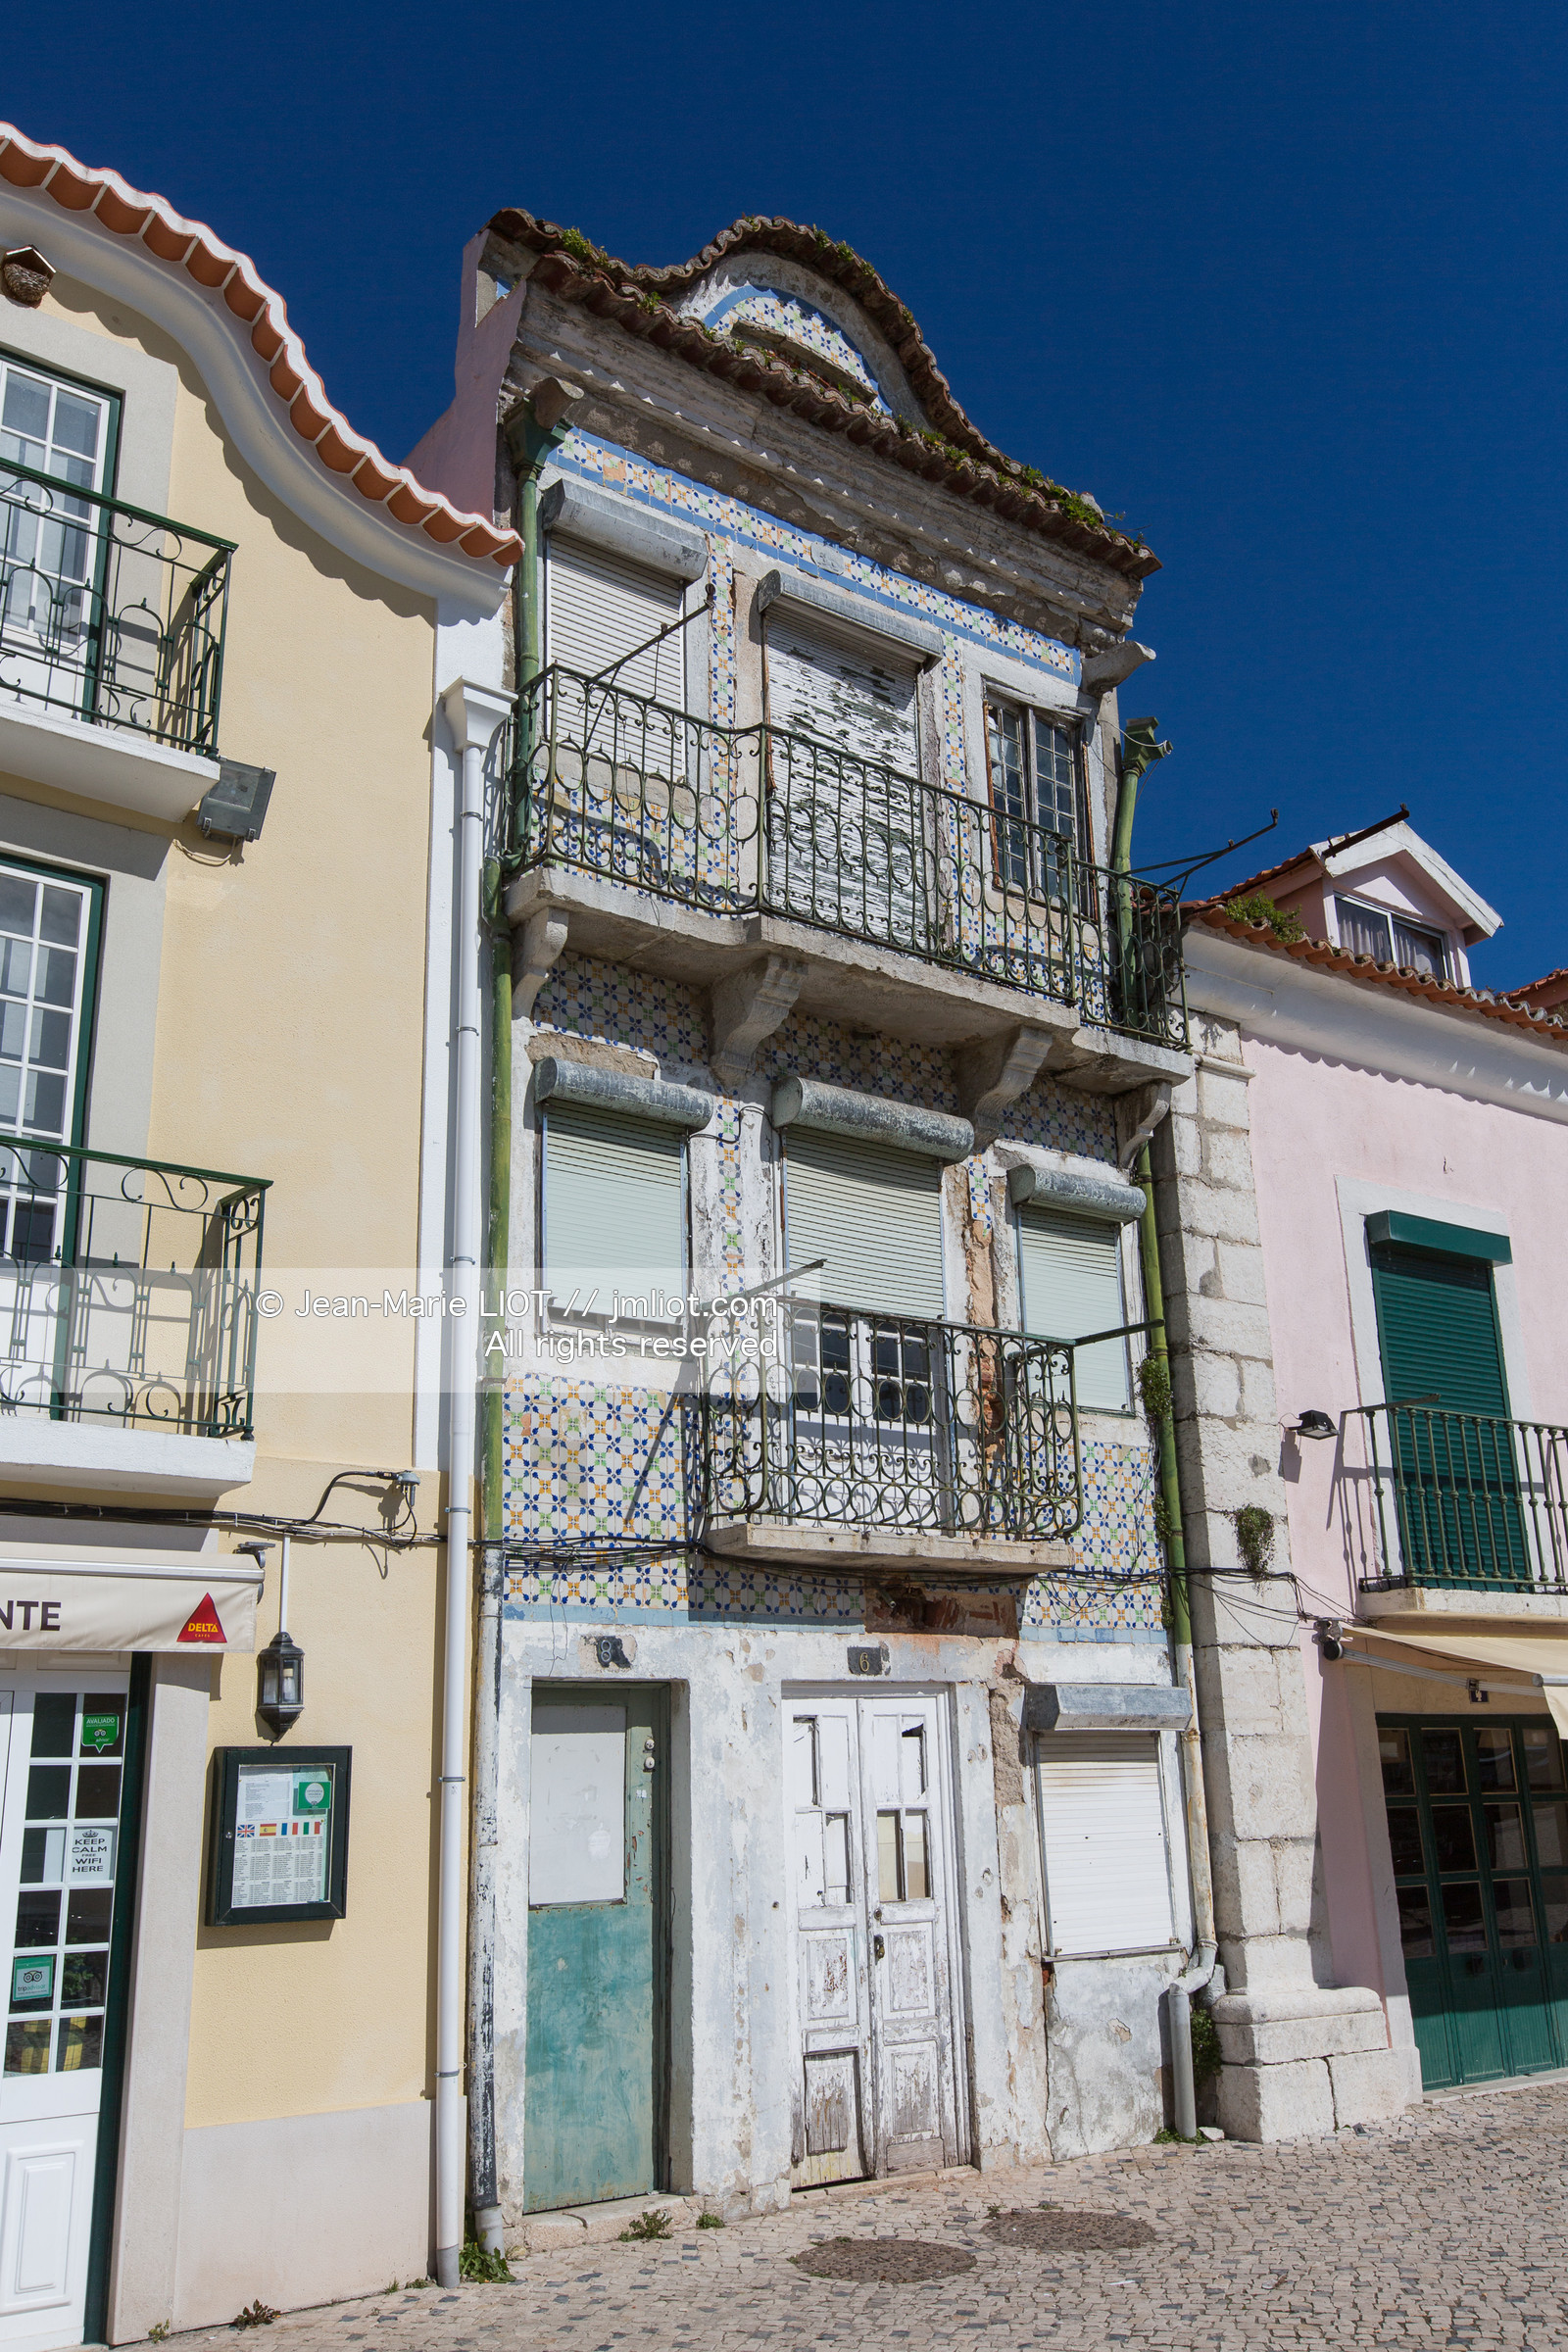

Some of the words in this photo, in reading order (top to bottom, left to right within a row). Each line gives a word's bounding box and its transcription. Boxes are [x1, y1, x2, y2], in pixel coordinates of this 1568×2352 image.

[0, 1600, 62, 1631] NTE
[187, 1622, 219, 1633] DELTA
[601, 1640, 612, 1662] 8
[859, 1652, 870, 1672] 6
